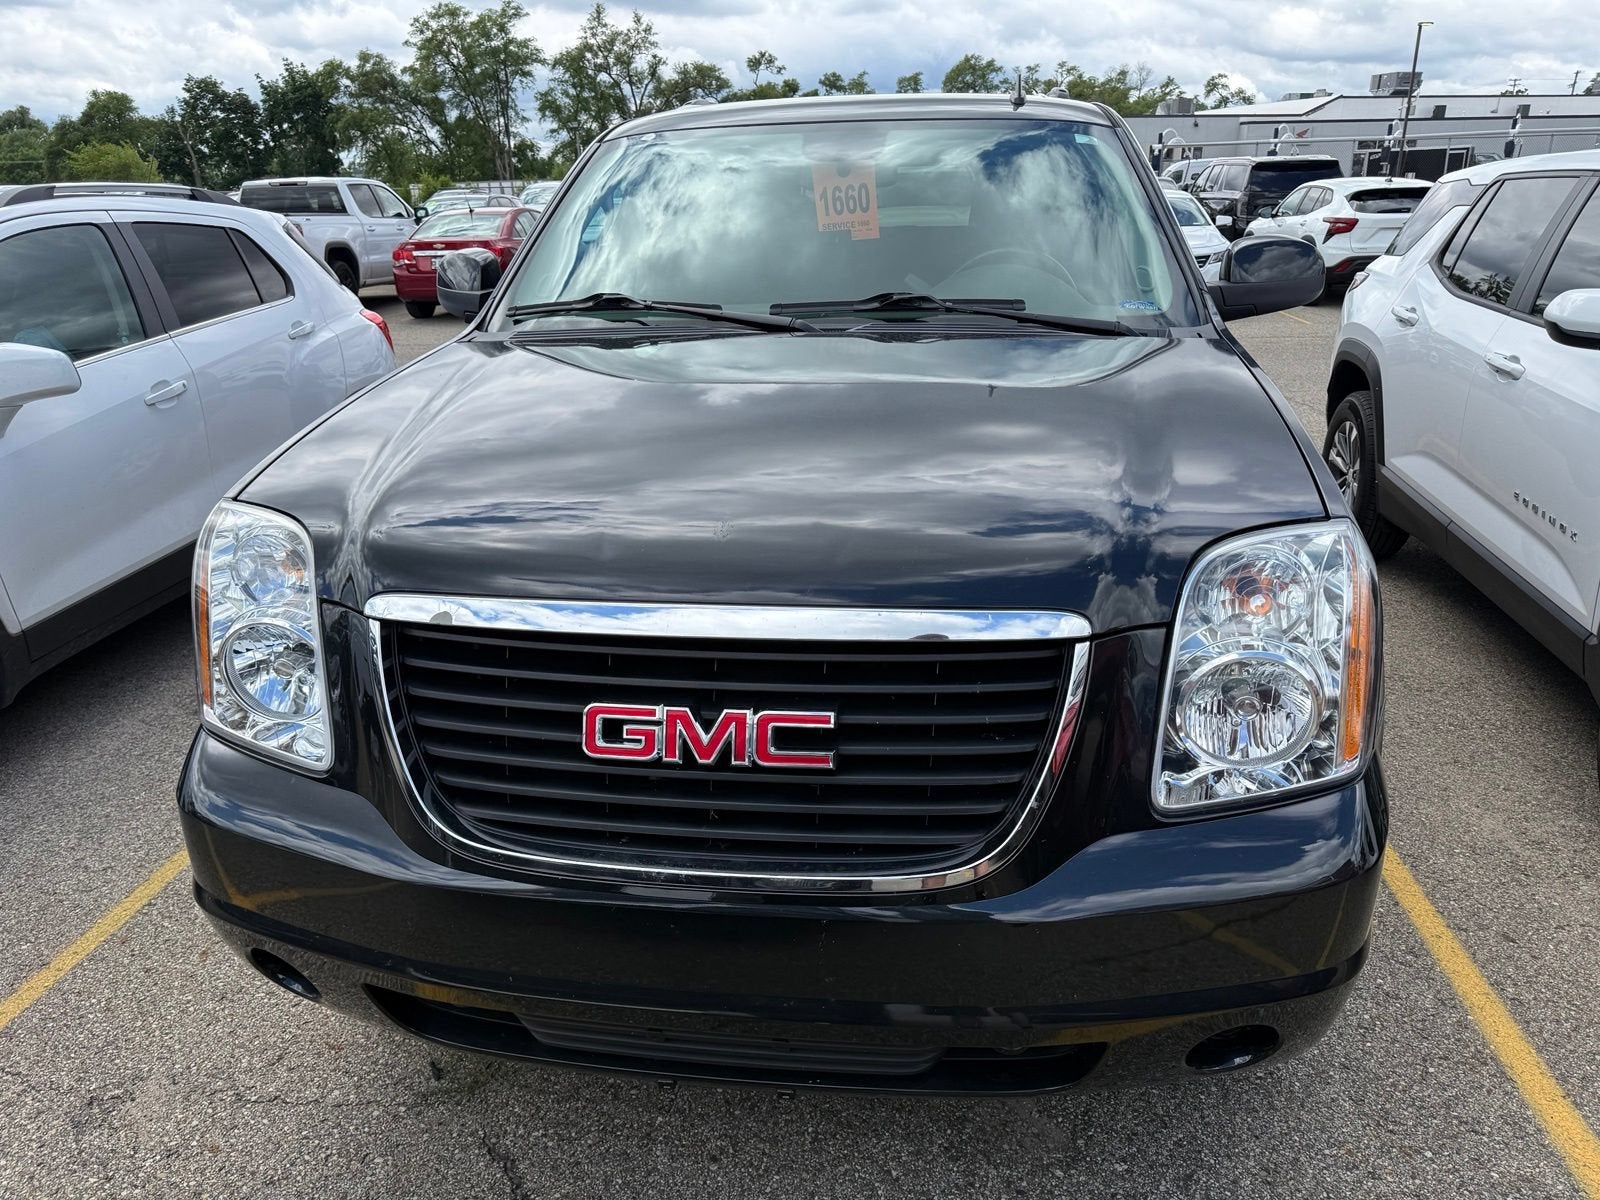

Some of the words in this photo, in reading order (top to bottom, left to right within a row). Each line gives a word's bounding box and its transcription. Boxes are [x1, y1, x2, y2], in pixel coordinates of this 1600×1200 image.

[819, 182, 870, 217] 1660
[822, 221, 856, 231] SERVICE
[582, 703, 837, 770] GMC
